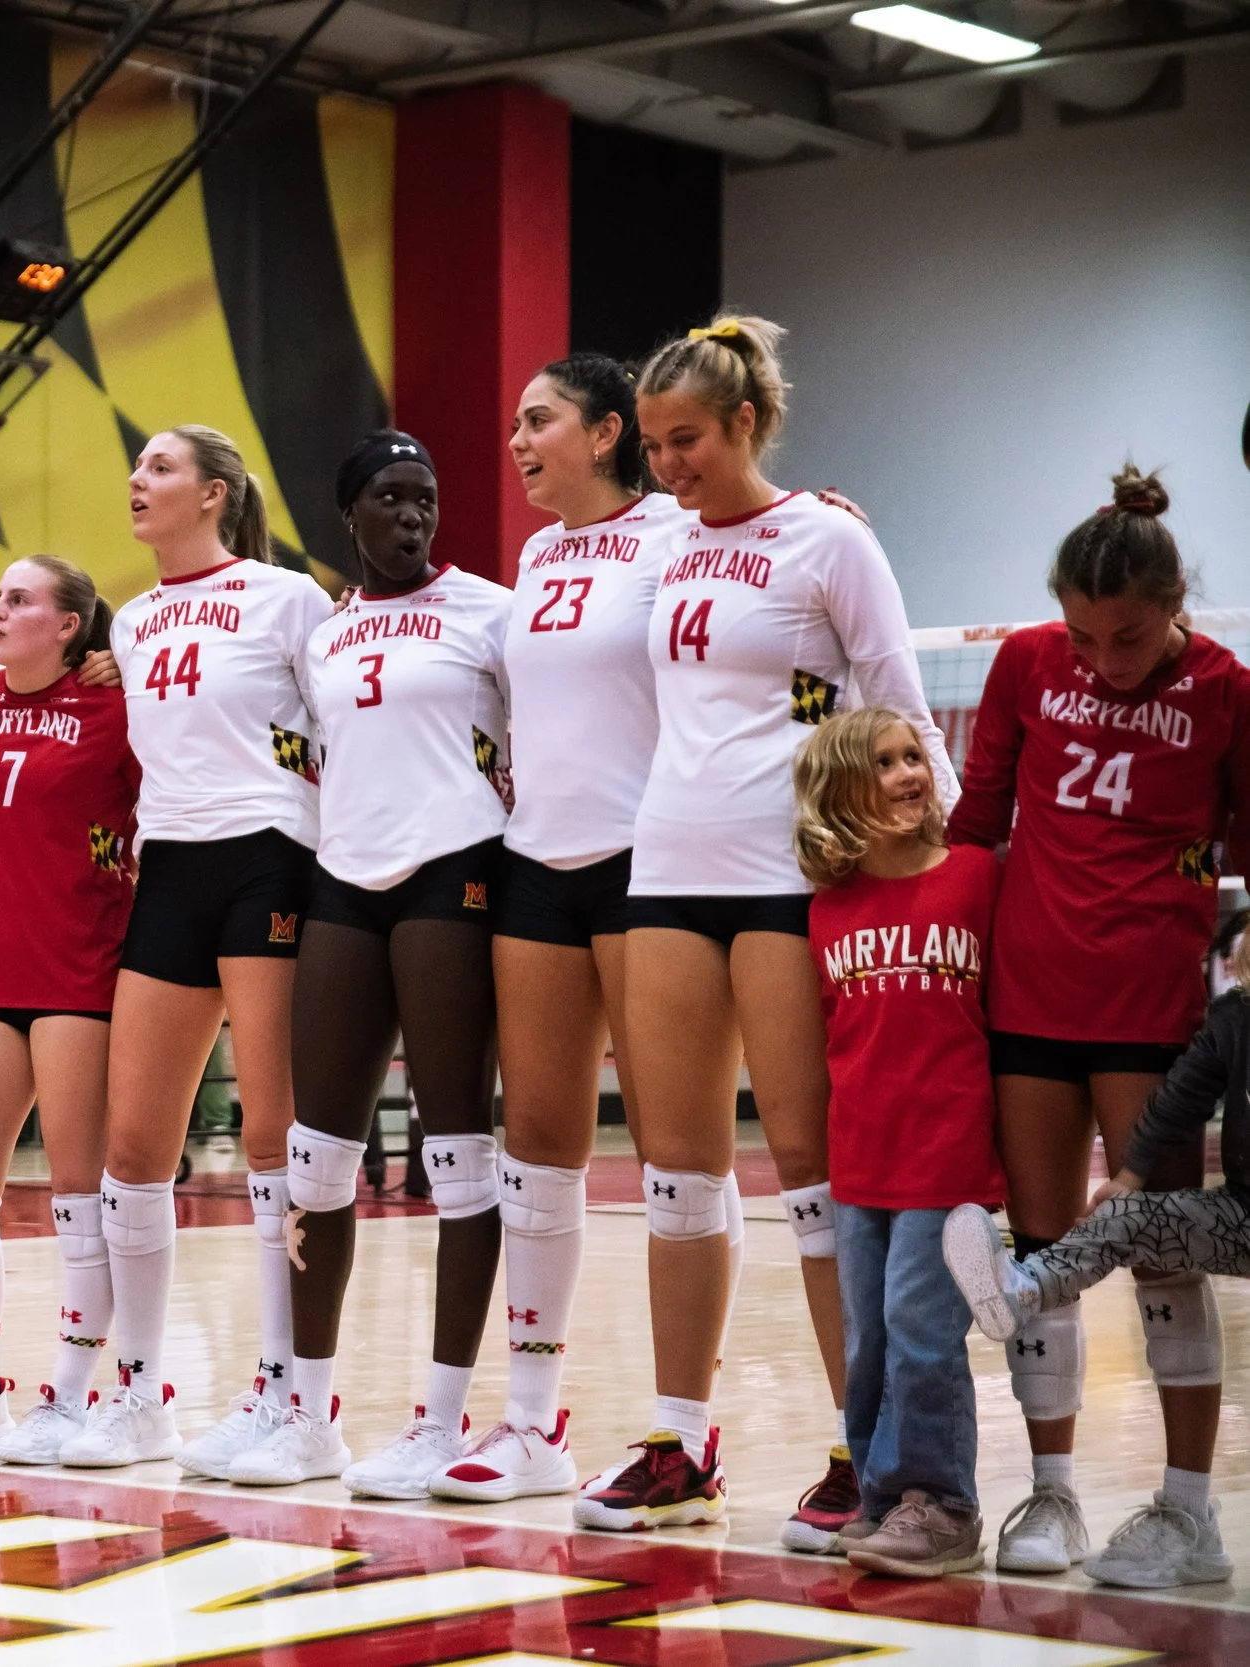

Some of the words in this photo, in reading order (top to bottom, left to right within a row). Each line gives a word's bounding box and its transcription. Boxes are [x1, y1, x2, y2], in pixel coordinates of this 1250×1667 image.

[528, 533, 640, 575] MARYLAND
[660, 548, 772, 590] MARYLAND
[132, 600, 240, 650] MARYLAND
[529, 576, 594, 633] 23
[669, 599, 714, 661] 14
[324, 613, 442, 661] MARYLAND
[145, 642, 201, 700] 44
[355, 653, 384, 708] 3
[1040, 689, 1193, 750] MARYLAND
[1, 751, 27, 807] 7
[1055, 741, 1135, 816] 24
[824, 924, 981, 984] MARYLAND
[842, 975, 964, 998] LLEYBAL
